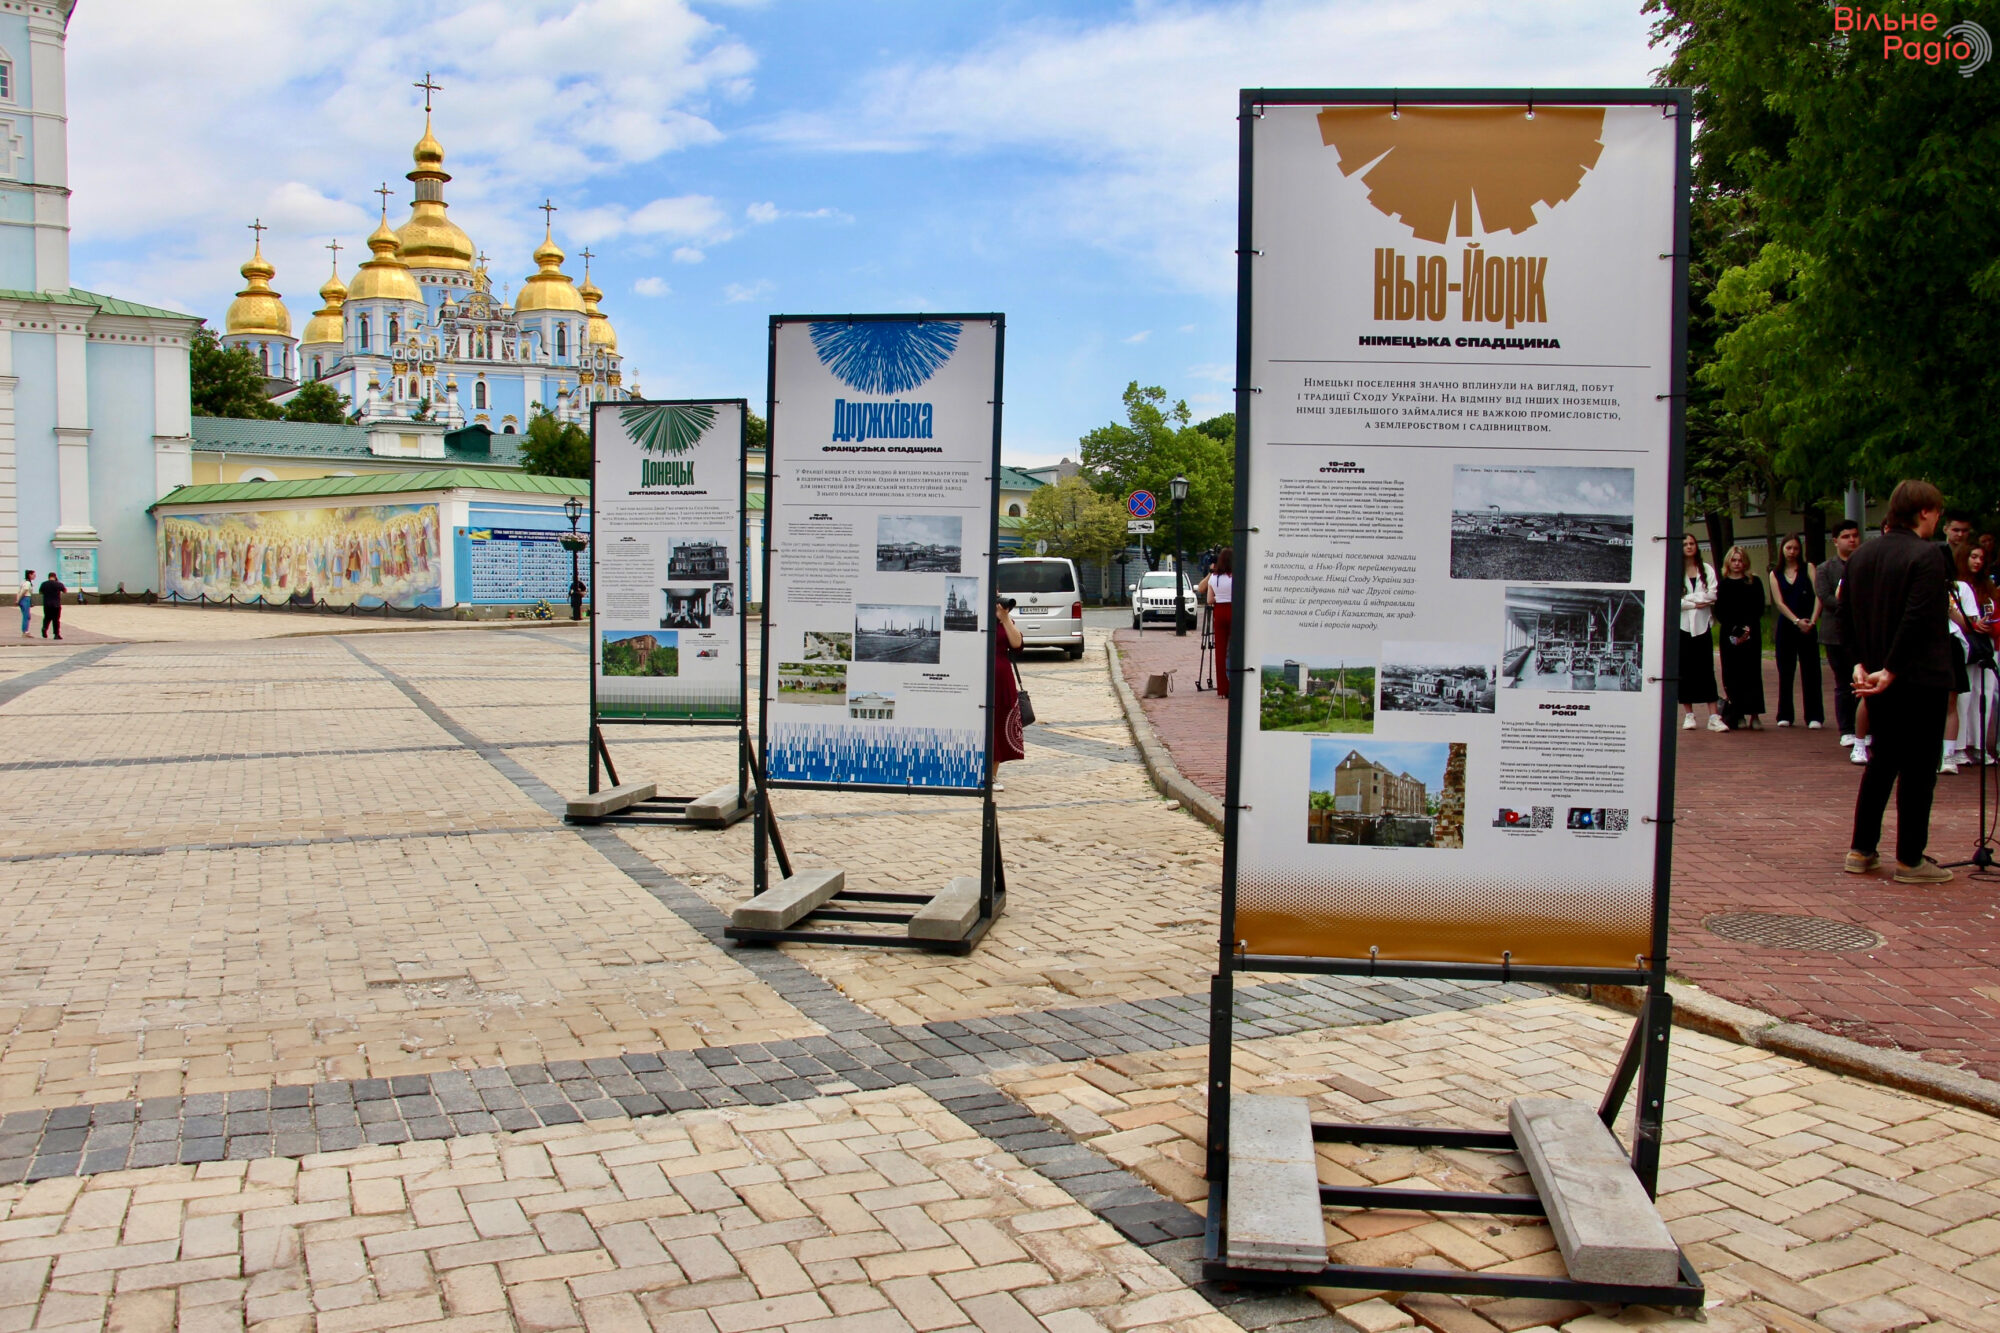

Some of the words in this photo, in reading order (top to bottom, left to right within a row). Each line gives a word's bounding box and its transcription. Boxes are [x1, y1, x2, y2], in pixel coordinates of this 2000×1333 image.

[1374, 242, 1548, 329] Нью-Йорк
[1358, 336, 1452, 349] НІМЕЦЬКА
[1454, 337, 1561, 350] СПАДЩИНА
[1304, 378, 1353, 388] НІМЕЦЬКІ
[1357, 380, 1416, 388] ПОСЕЛЕННЯ
[1420, 381, 1459, 389] ЗНАЧНО
[1462, 382, 1516, 390] ВПЛИНУЛИ
[1537, 383, 1578, 392] ВИГЛЯД,
[1306, 391, 1349, 401] ТРАДИЦІЇ
[1354, 392, 1386, 402] СХОДУ
[1392, 392, 1437, 402] УКРАЇНИ.
[1460, 396, 1502, 404] ВІДМІНУ
[1506, 396, 1521, 405] ВІД
[1526, 397, 1558, 405] ІНШИХ
[1563, 398, 1619, 407] ІНОЗЕМЦІВ,
[832, 399, 932, 442] Дружківка
[1296, 406, 1326, 415] НІМЦІ
[1329, 407, 1399, 416] ЗДЕБІЛЬШОГО
[1402, 406, 1463, 416] ЗАЙМАЛИСЯ
[1482, 410, 1527, 418] ВАЖКОЮ
[1530, 411, 1621, 421] ПРОМИСЛОВІСТЮ,
[1374, 422, 1460, 430] ЗЕМЛЕРОБСТВОМ
[1469, 423, 1552, 432] САДІВНИЦТВОМ.
[642, 459, 694, 488] Донецьк
